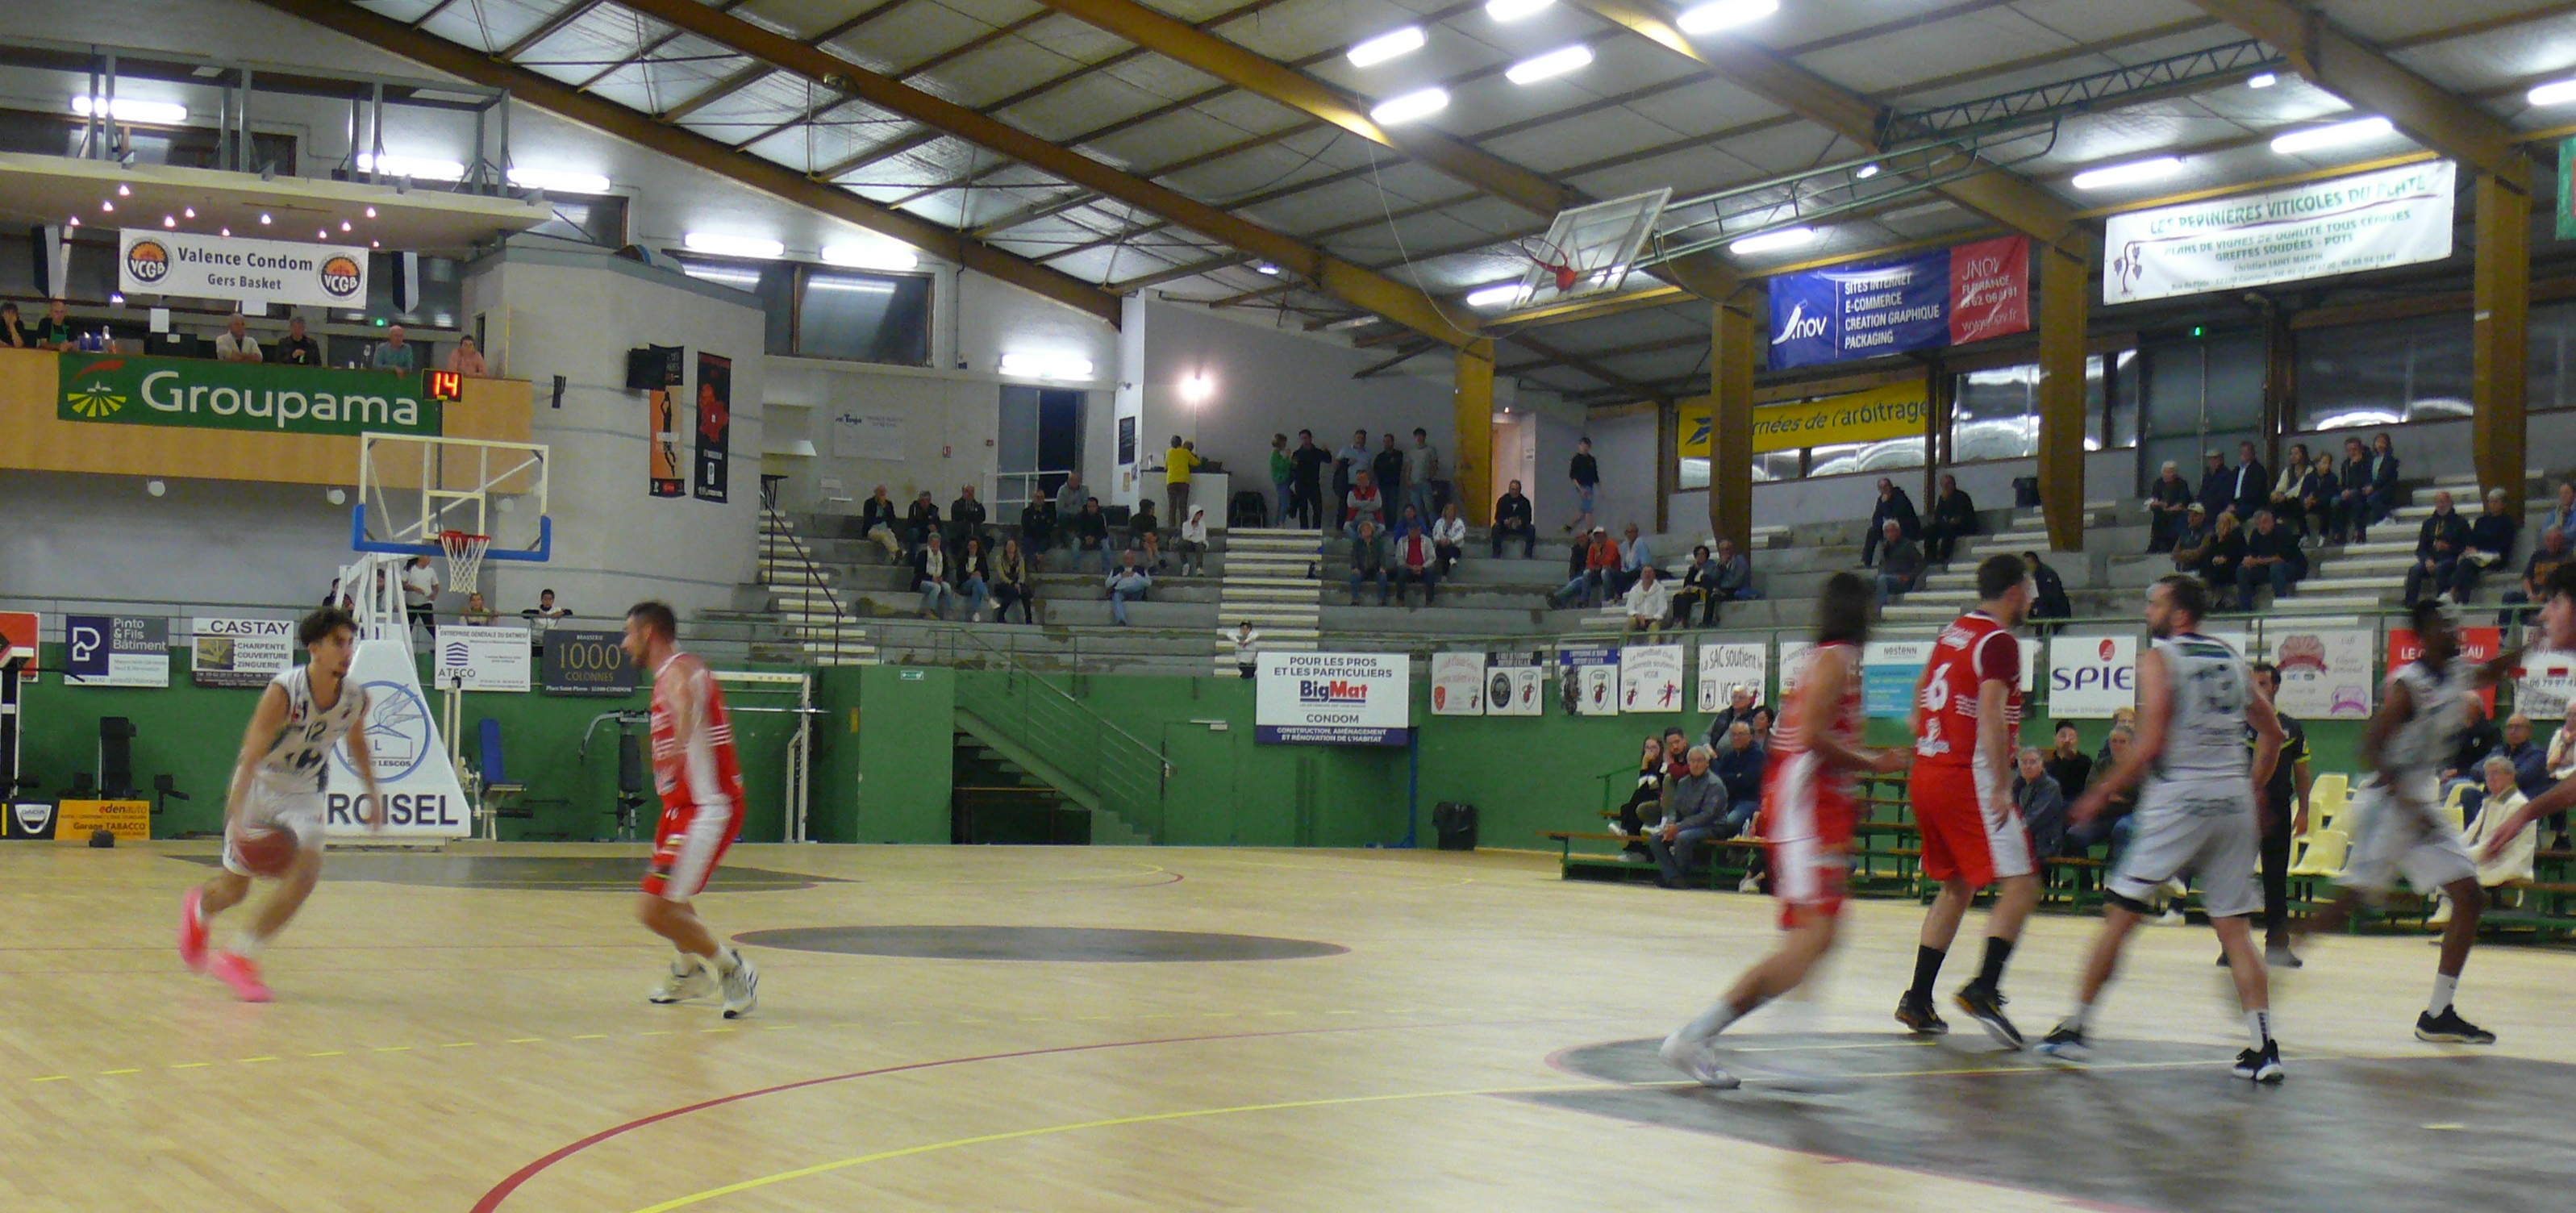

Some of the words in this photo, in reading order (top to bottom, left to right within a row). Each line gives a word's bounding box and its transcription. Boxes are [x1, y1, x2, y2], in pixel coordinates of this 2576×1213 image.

[2266, 191, 2343, 218] VITICOLES
[2348, 185, 2370, 202] DU
[2199, 242, 2213, 252] DE
[2326, 220, 2357, 233] TOUS
[177, 247, 241, 266] Valence
[246, 252, 313, 271] Condom
[2215, 247, 2260, 262] GREFFES
[2263, 238, 2313, 255] SOUDÉES
[130, 259, 165, 279] VCGB
[1961, 256, 2000, 281] JNOV
[2268, 257, 2290, 269] SAINT
[2292, 253, 2324, 264] MARTIN
[207, 273, 236, 287] Gers
[240, 276, 282, 290] Basket
[323, 274, 358, 293] VCGB
[1844, 281, 1868, 295] SITES
[1869, 272, 1912, 290] INTERNET
[1844, 291, 1903, 314] E-COMMERCE
[1844, 314, 1886, 332] CREATION
[1888, 304, 1940, 325] GRAPHIQUE
[1844, 330, 1894, 350] PACKAGING
[432, 371, 460, 398] 14
[140, 370, 419, 429] Groupama
[1753, 415, 1802, 436] rnées
[1804, 411, 1828, 431] de
[114, 618, 145, 629] Pinto
[210, 620, 290, 635] CASTAY
[114, 628, 122, 640] &
[124, 629, 144, 640] Fils
[113, 639, 167, 652] Bâtiment
[237, 642, 286, 651] CHARPENTE
[2400, 646, 2416, 660] LE
[237, 652, 289, 660] COUVERTURE
[237, 661, 281, 669] ZINGUERIE
[559, 642, 621, 670] 1000
[1290, 657, 1322, 667] POUR
[1324, 657, 1344, 667] LES
[1346, 657, 1377, 667] PROS
[1709, 646, 1724, 669] SAC
[1725, 646, 1757, 670] soutient
[438, 668, 476, 678] ATECO
[565, 671, 614, 682] COLONNES
[1274, 667, 1288, 677] ET
[1290, 667, 1311, 677] LES
[1313, 668, 1392, 678] PARTICULIERS
[2052, 665, 2134, 691] SPIE
[1299, 680, 1368, 703] BigMat
[1926, 662, 1953, 712] 6
[1306, 714, 1360, 724] CONDOM
[304, 720, 328, 743] 12
[1333, 727, 1387, 736] AMÉNAGEMENT
[374, 739, 382, 751] L
[73, 822, 103, 831] Garage
[106, 823, 146, 831] TABACCO
